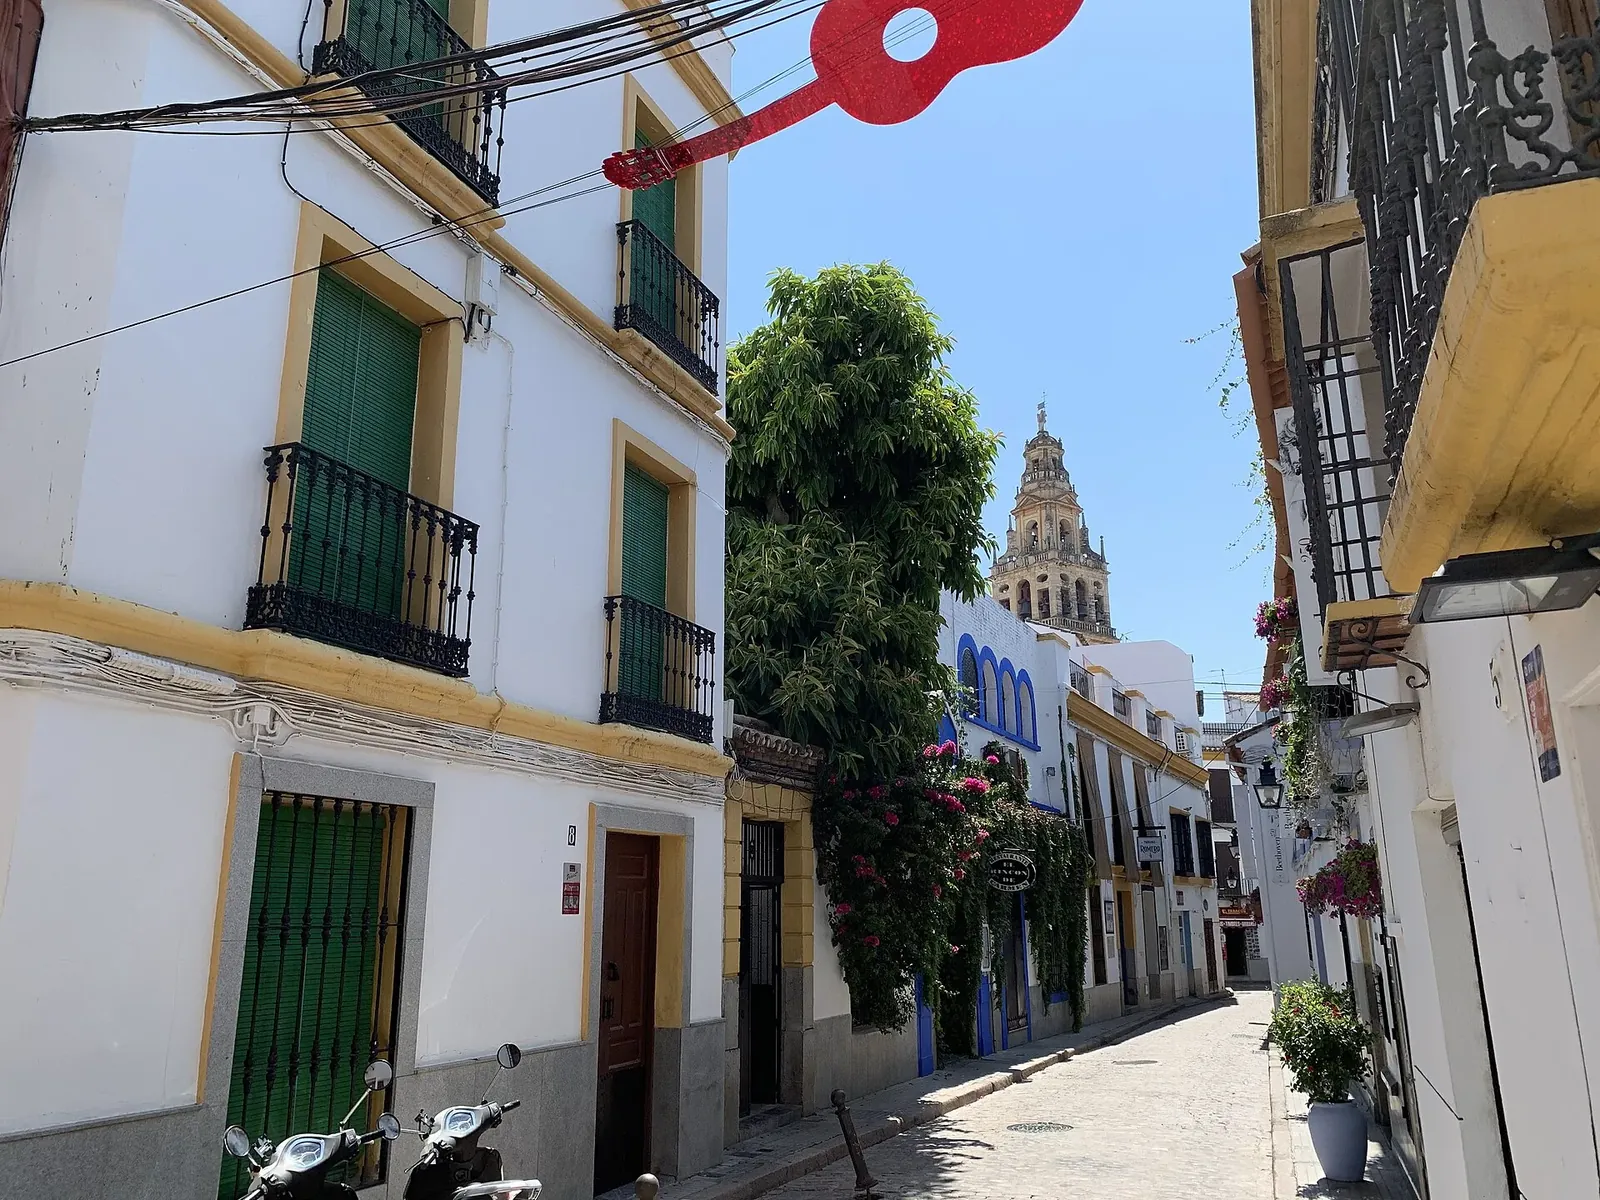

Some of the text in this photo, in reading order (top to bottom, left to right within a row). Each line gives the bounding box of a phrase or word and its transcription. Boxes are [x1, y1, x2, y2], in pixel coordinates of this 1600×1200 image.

[569, 826, 575, 844] 8
[1275, 837, 1283, 871] Beethoven
[989, 879, 1029, 891] CARMEN
